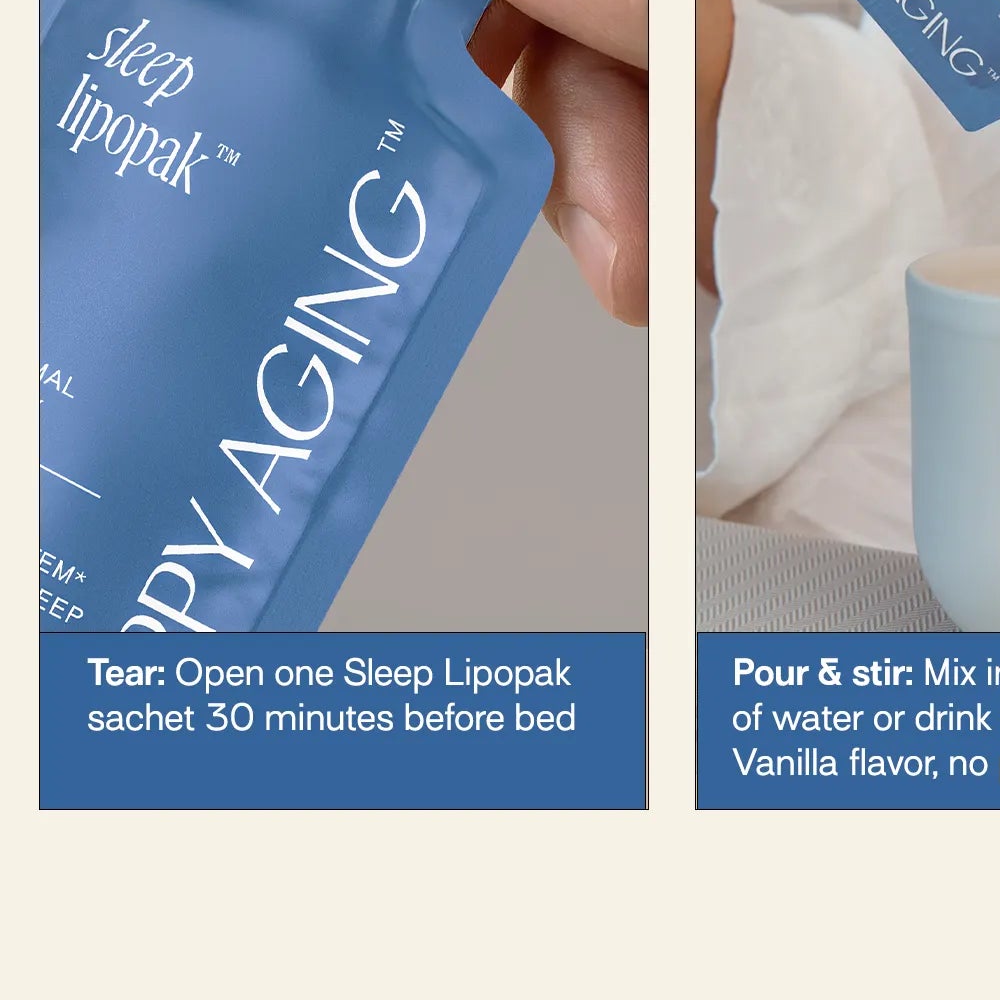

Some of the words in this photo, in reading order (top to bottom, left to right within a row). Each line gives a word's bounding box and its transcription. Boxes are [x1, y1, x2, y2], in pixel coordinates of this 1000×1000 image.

[86, 18, 194, 107] sleep
[57, 74, 209, 194] lipopak
[218, 169, 427, 515] AGING
